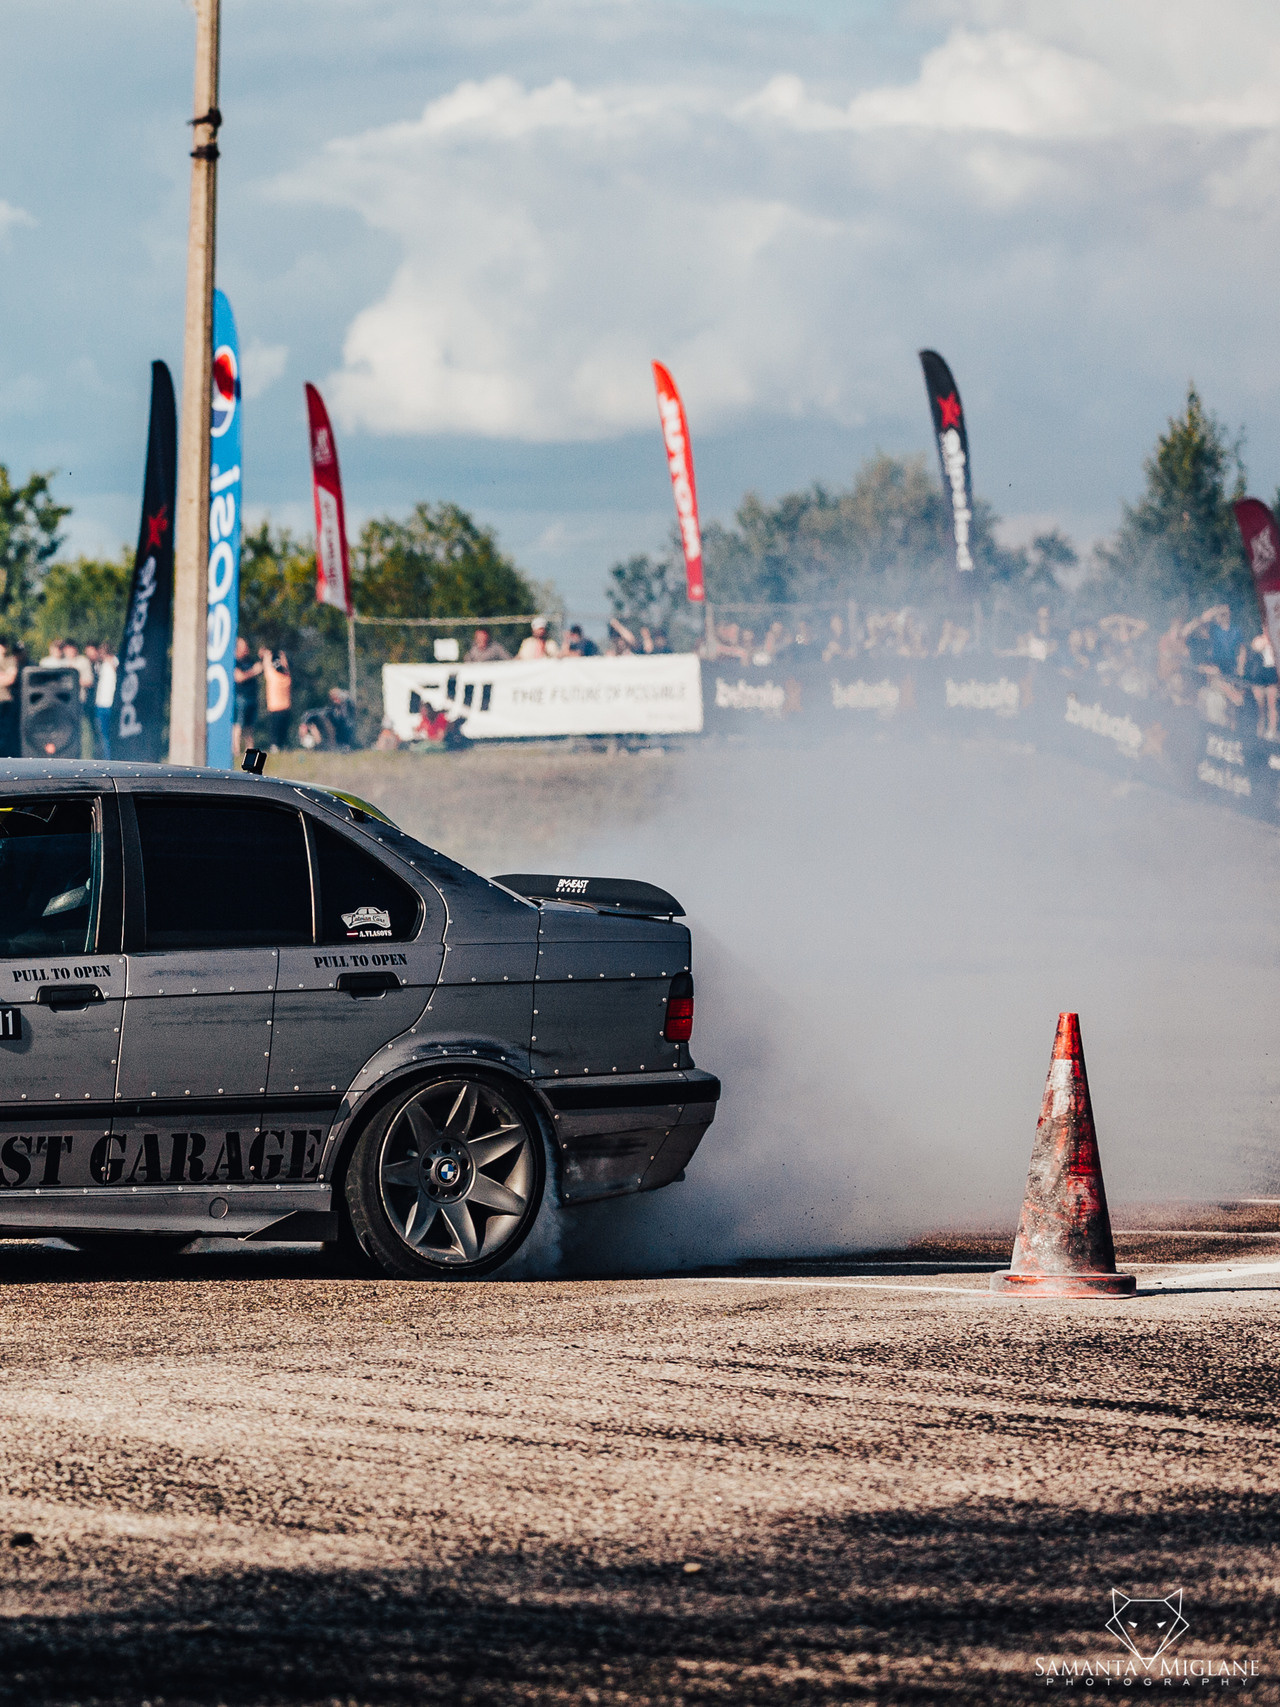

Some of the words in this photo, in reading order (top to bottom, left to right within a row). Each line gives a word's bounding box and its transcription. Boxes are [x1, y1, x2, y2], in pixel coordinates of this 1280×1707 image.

[314, 956, 349, 968] PULL
[350, 955, 369, 967] TO
[372, 953, 408, 966] OPEN
[13, 969, 49, 982] PULL
[51, 968, 70, 980] TO
[74, 965, 111, 978] OPEN
[89, 1128, 323, 1185] GARAGE
